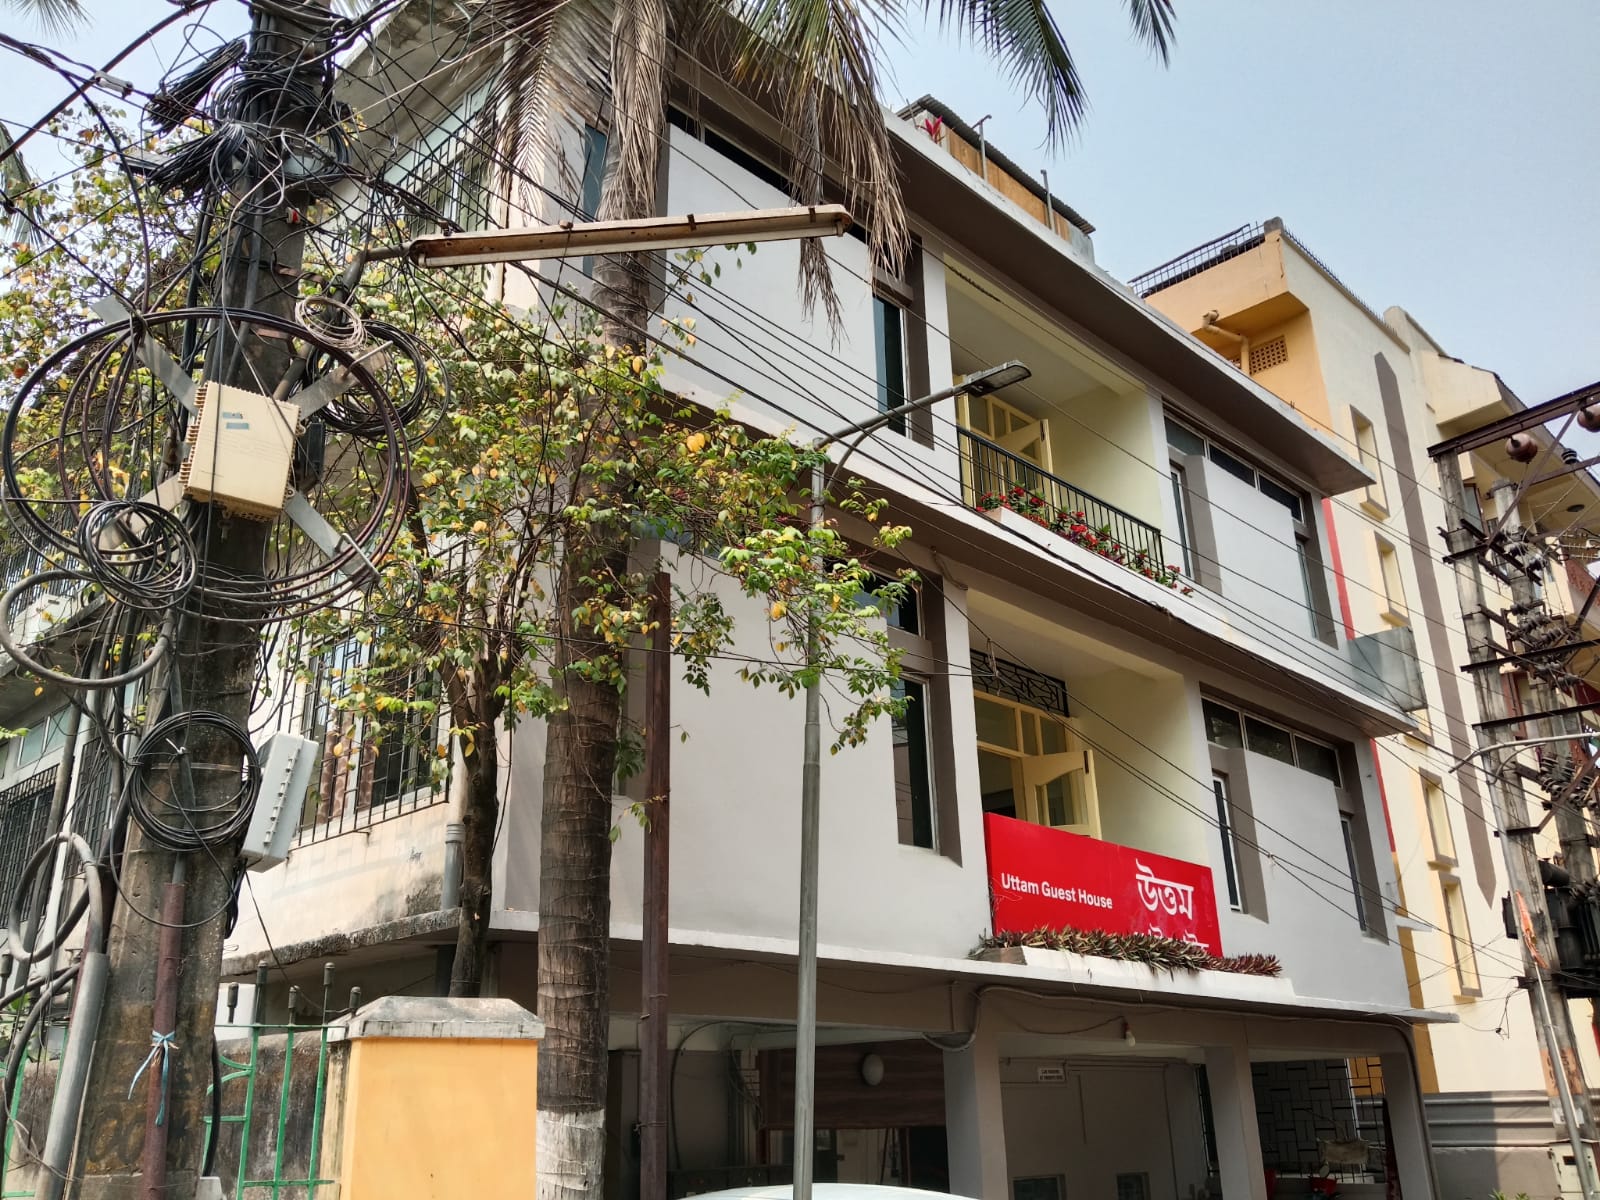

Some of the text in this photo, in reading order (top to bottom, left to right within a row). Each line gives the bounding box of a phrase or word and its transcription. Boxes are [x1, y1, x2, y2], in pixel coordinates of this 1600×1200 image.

[1001, 872, 1113, 910] Uttam Guest House
[1135, 858, 1194, 920] উত্তম
